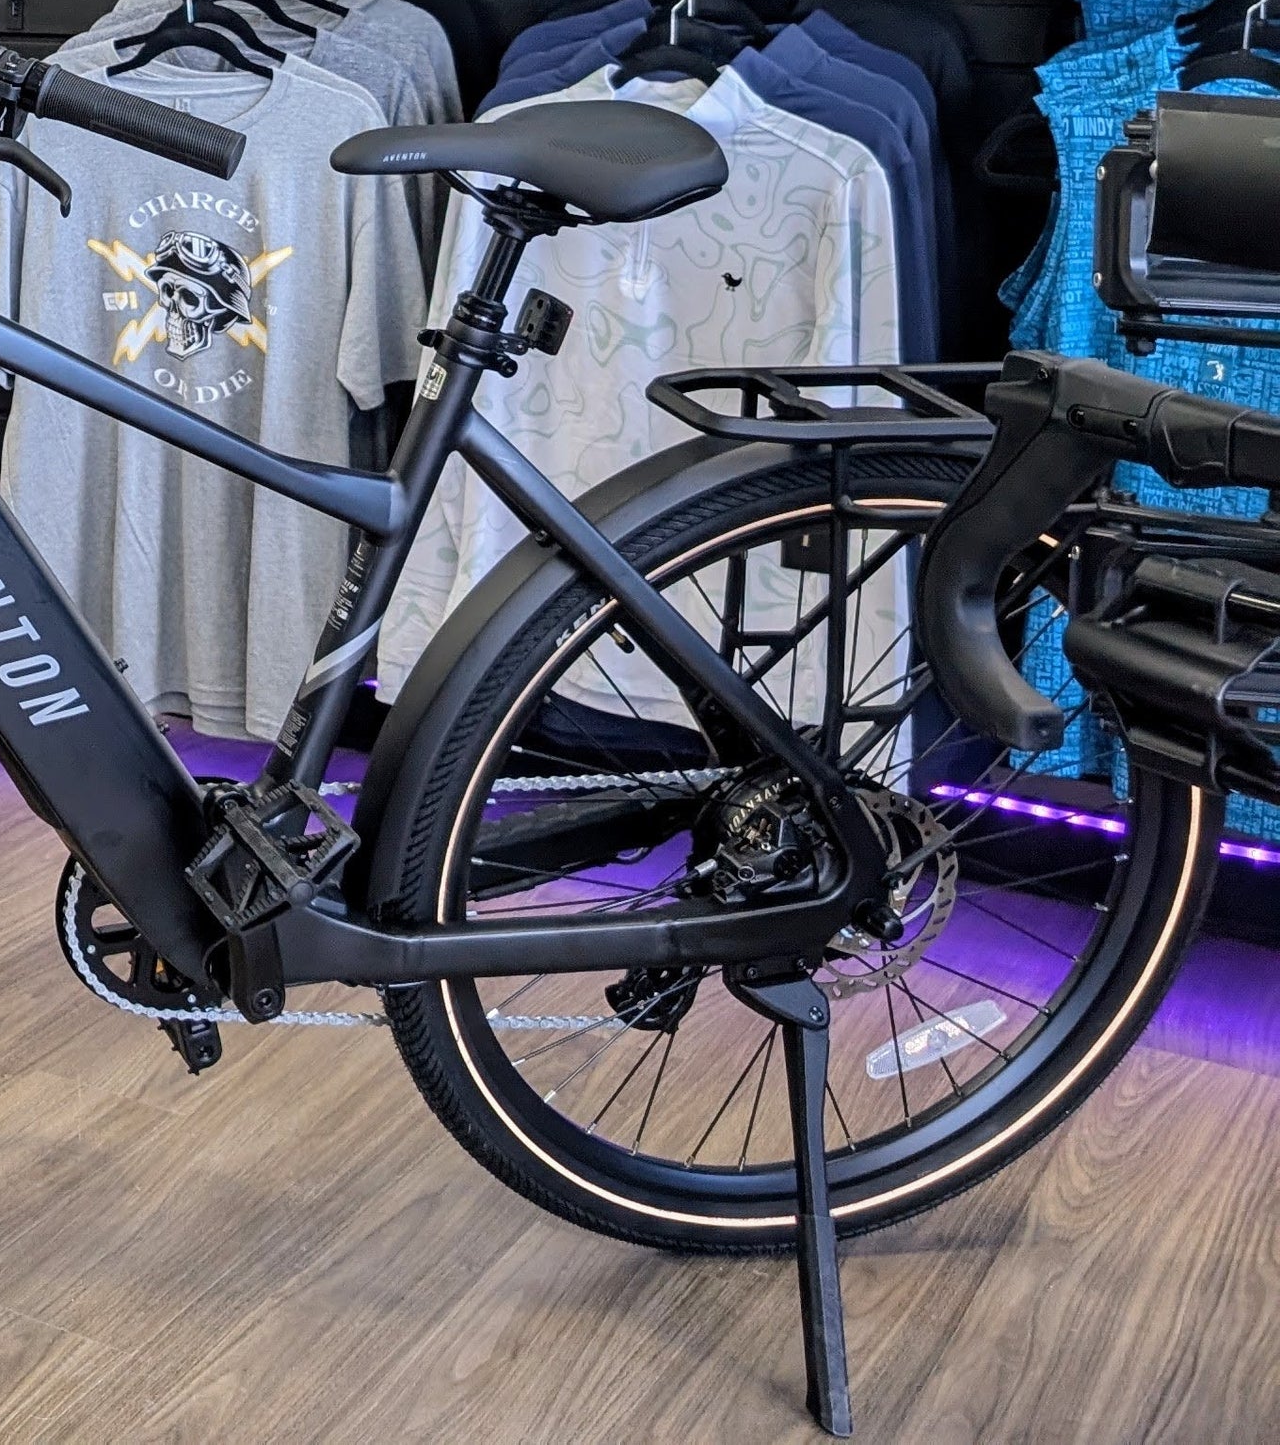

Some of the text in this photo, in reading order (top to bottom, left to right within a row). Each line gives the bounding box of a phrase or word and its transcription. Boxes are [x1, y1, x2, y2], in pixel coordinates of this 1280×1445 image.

[1072, 117, 1114, 137] WINDY
[383, 153, 427, 162] AVENTON
[128, 191, 260, 233] CHARGE
[196, 369, 252, 404] DIE
